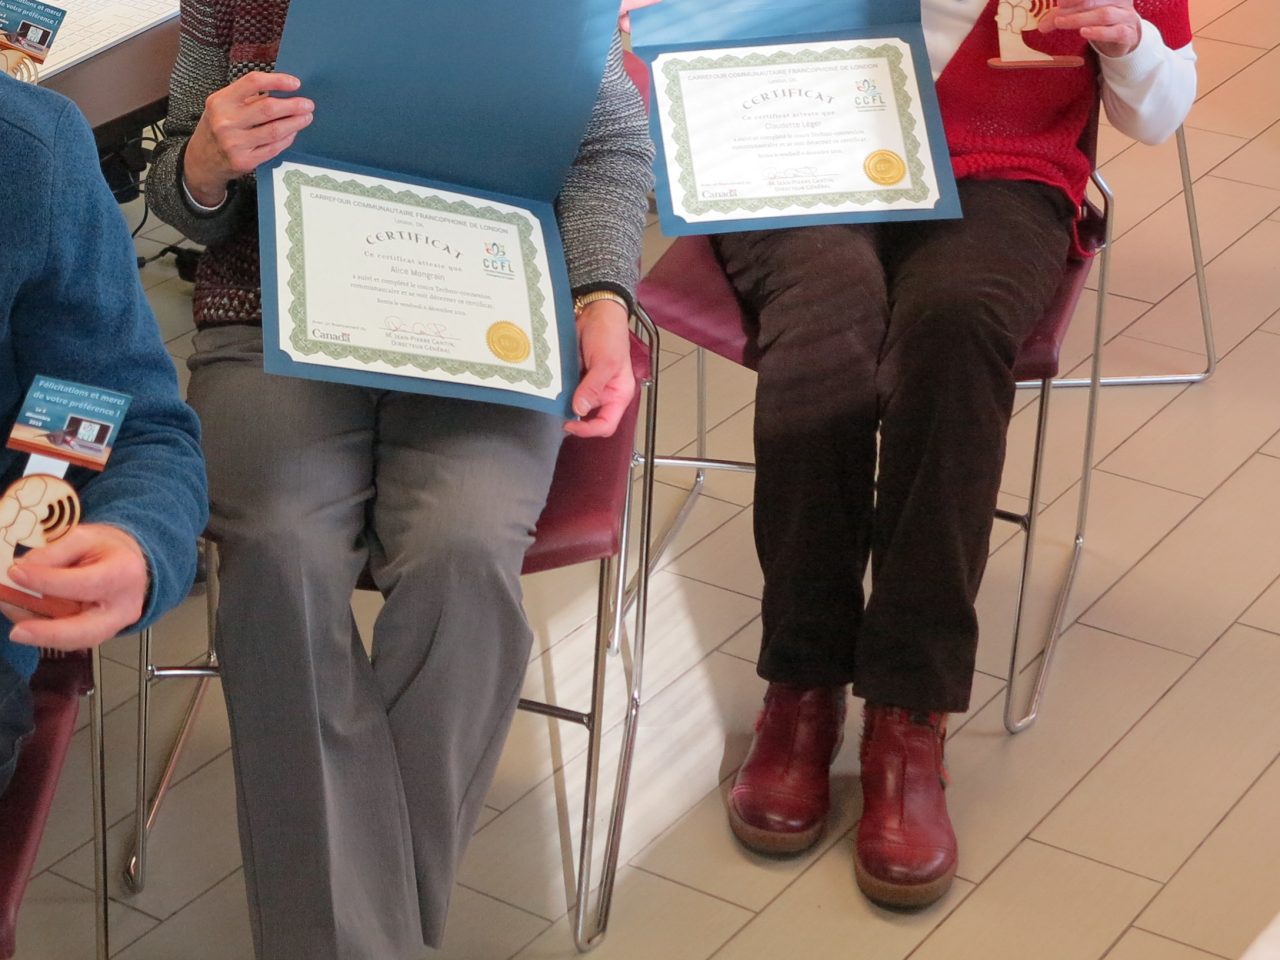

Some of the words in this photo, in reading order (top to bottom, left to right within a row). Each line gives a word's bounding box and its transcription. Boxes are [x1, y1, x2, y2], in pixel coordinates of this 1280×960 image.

[743, 88, 834, 110] CERTIFICAT
[855, 96, 886, 106] CCFL
[702, 188, 737, 199] Canada
[366, 230, 463, 259] CERTIFICAT
[391, 265, 409, 276] Alice
[483, 258, 514, 273] CCFL
[312, 328, 351, 343] Canada
[39, 380, 89, 397] Félicitations
[90, 392, 99, 400] et
[101, 395, 126, 406] merci
[34, 391, 45, 400] de
[46, 394, 69, 405] votre
[69, 400, 115, 416] préférence
